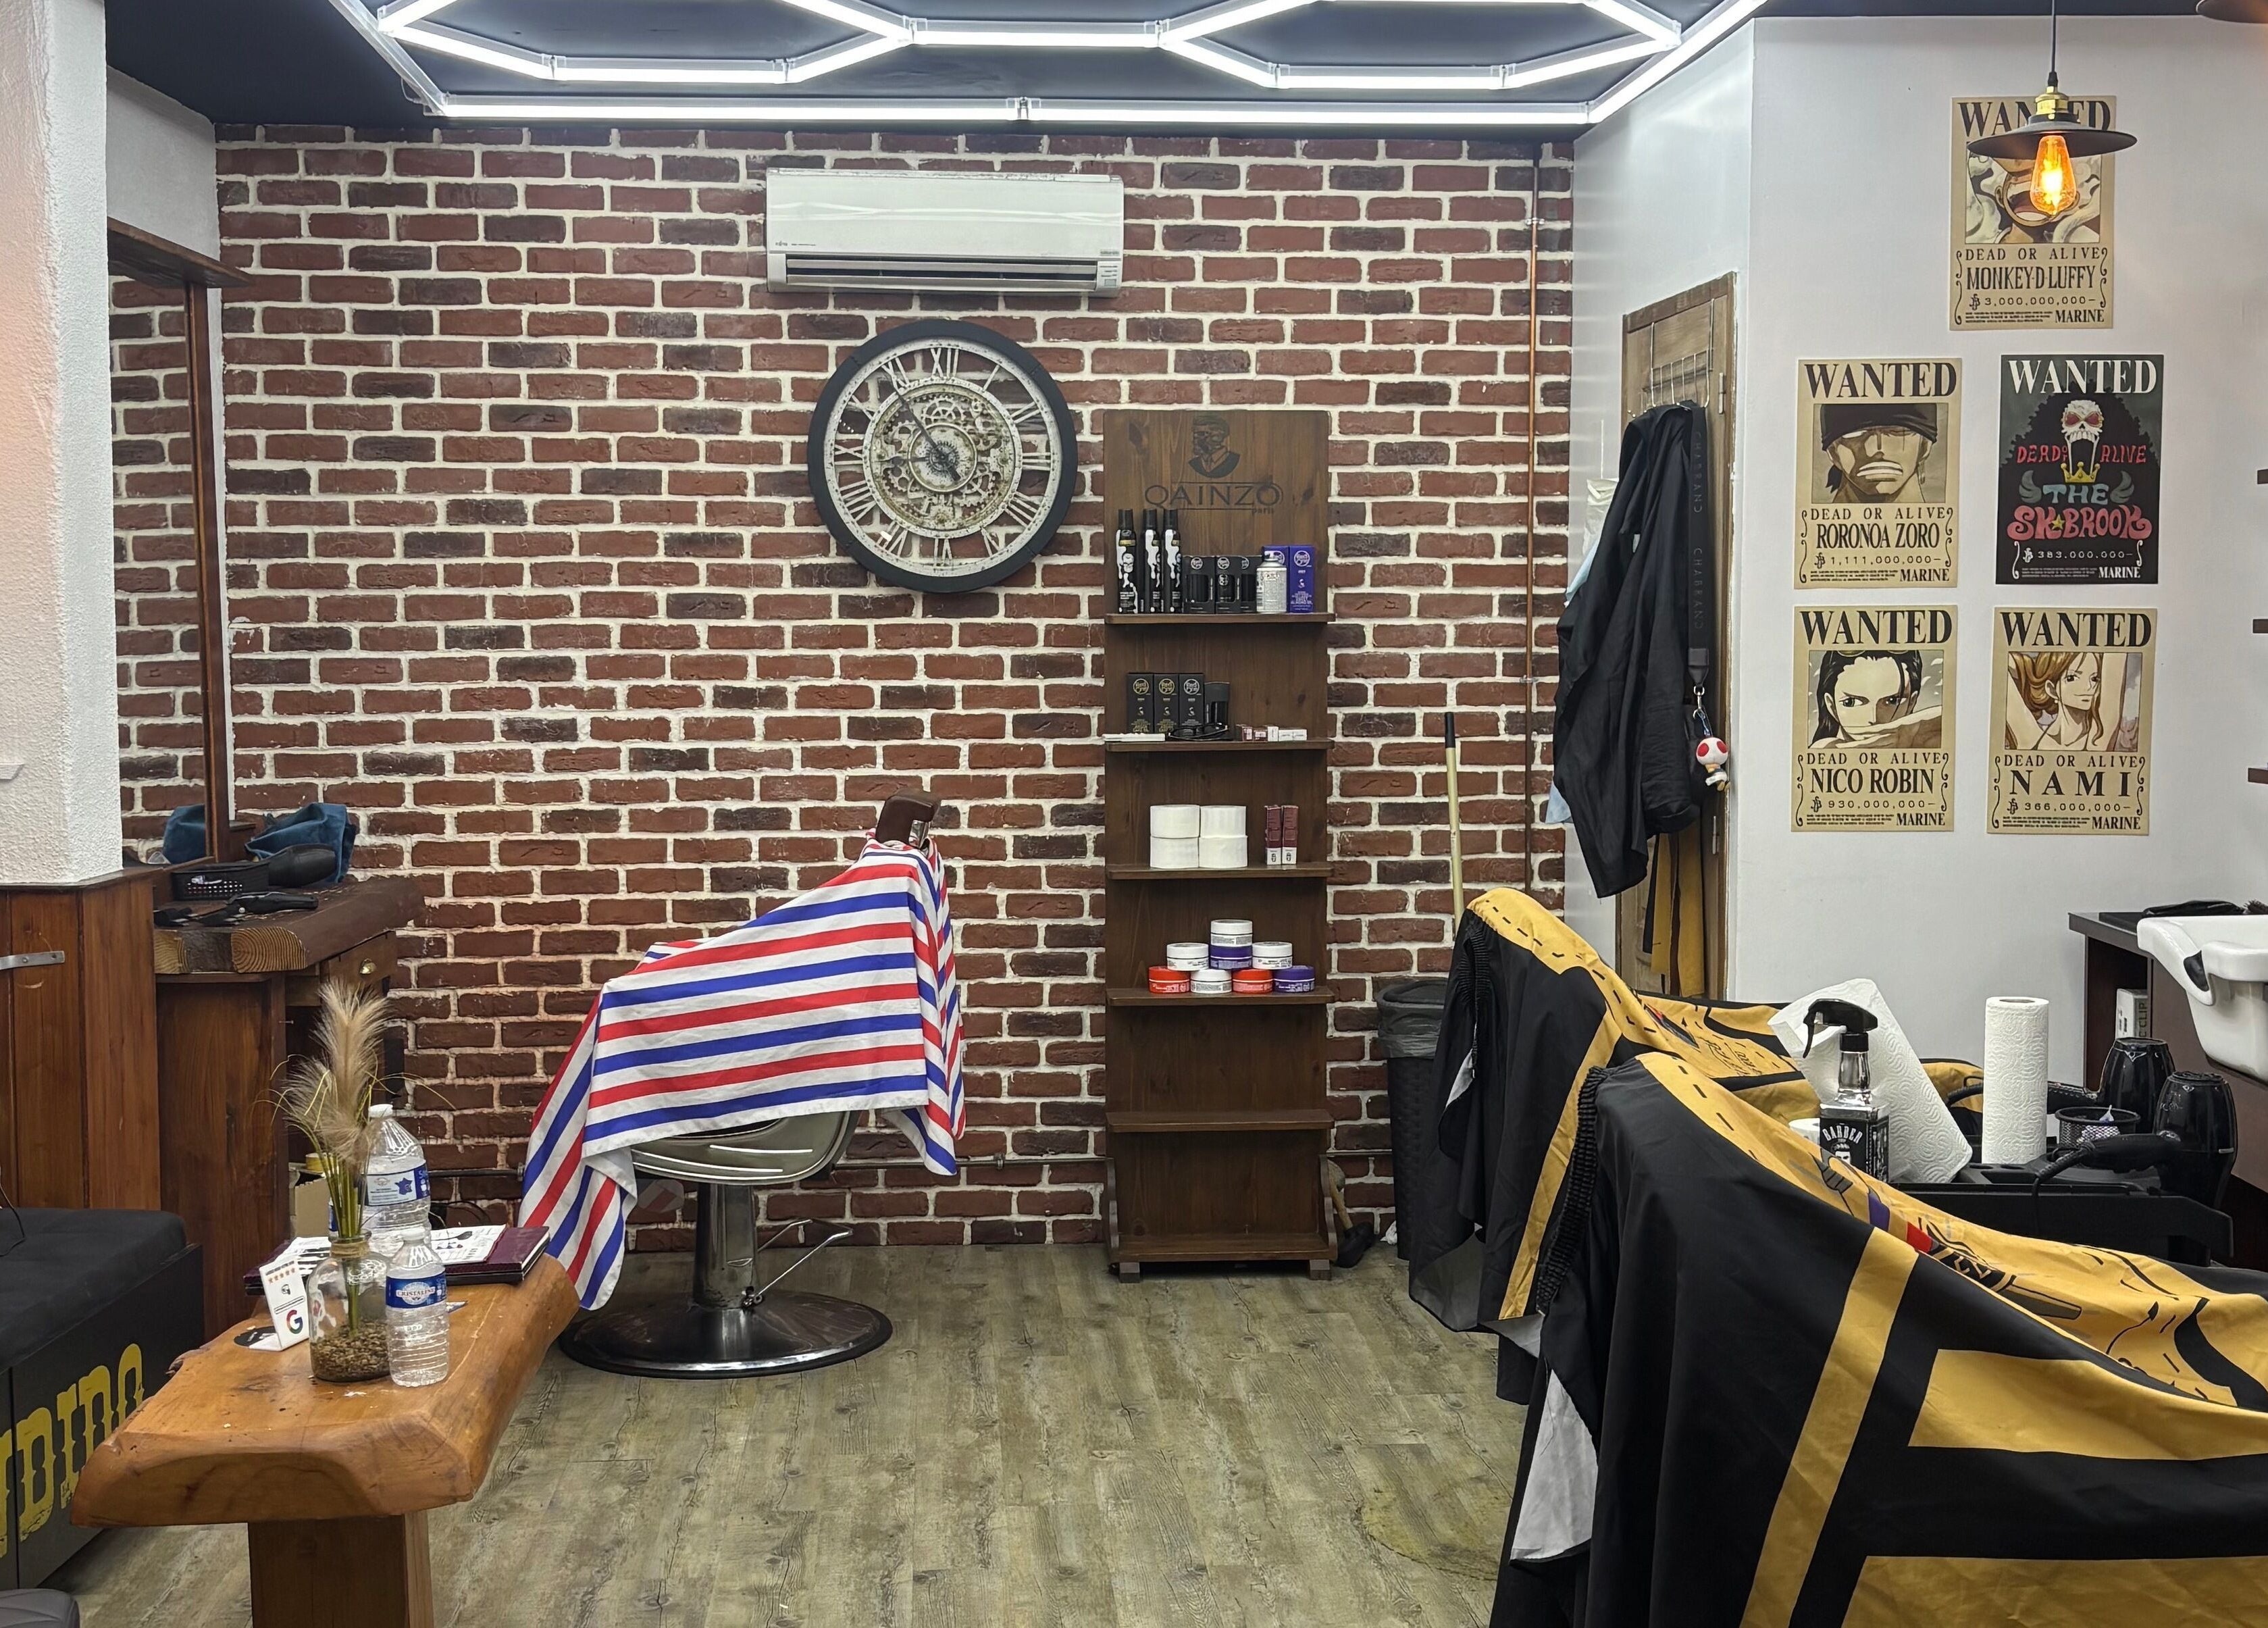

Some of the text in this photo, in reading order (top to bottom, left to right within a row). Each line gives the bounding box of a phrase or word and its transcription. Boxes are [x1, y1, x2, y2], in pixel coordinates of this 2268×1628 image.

[1965, 247, 2101, 261] DEAD OR ALIVE
[2055, 309, 2105, 324] MARINE
[1804, 362, 1957, 399] WANTED
[2008, 359, 2157, 395] WANTED
[2017, 444, 2061, 464] DEAD
[2100, 444, 2146, 463] ALIVE
[1145, 484, 1281, 509] QAINZO
[2042, 483, 2109, 505] THE
[1811, 507, 1945, 520] DEAD OR ALIVE
[1816, 522, 1940, 549] RORONOA ZORO
[1900, 568, 1949, 582] MARINE
[2098, 566, 2141, 579] MARINE
[1799, 609, 1953, 645] WANTED
[2000, 611, 2152, 647] WANTED
[1807, 752, 1941, 765] DEAD OR ALIVE
[2004, 755, 2138, 767] DEAD OR ALIVE
[1810, 768, 1934, 794] NICO ROBIN
[2009, 769, 2132, 797] NAMI
[1897, 813, 1946, 826] MARINE
[2092, 816, 2141, 830] MARINE
[2138, 1002, 2148, 1027] CLIP
[1822, 1125, 1863, 1144] BARBER
